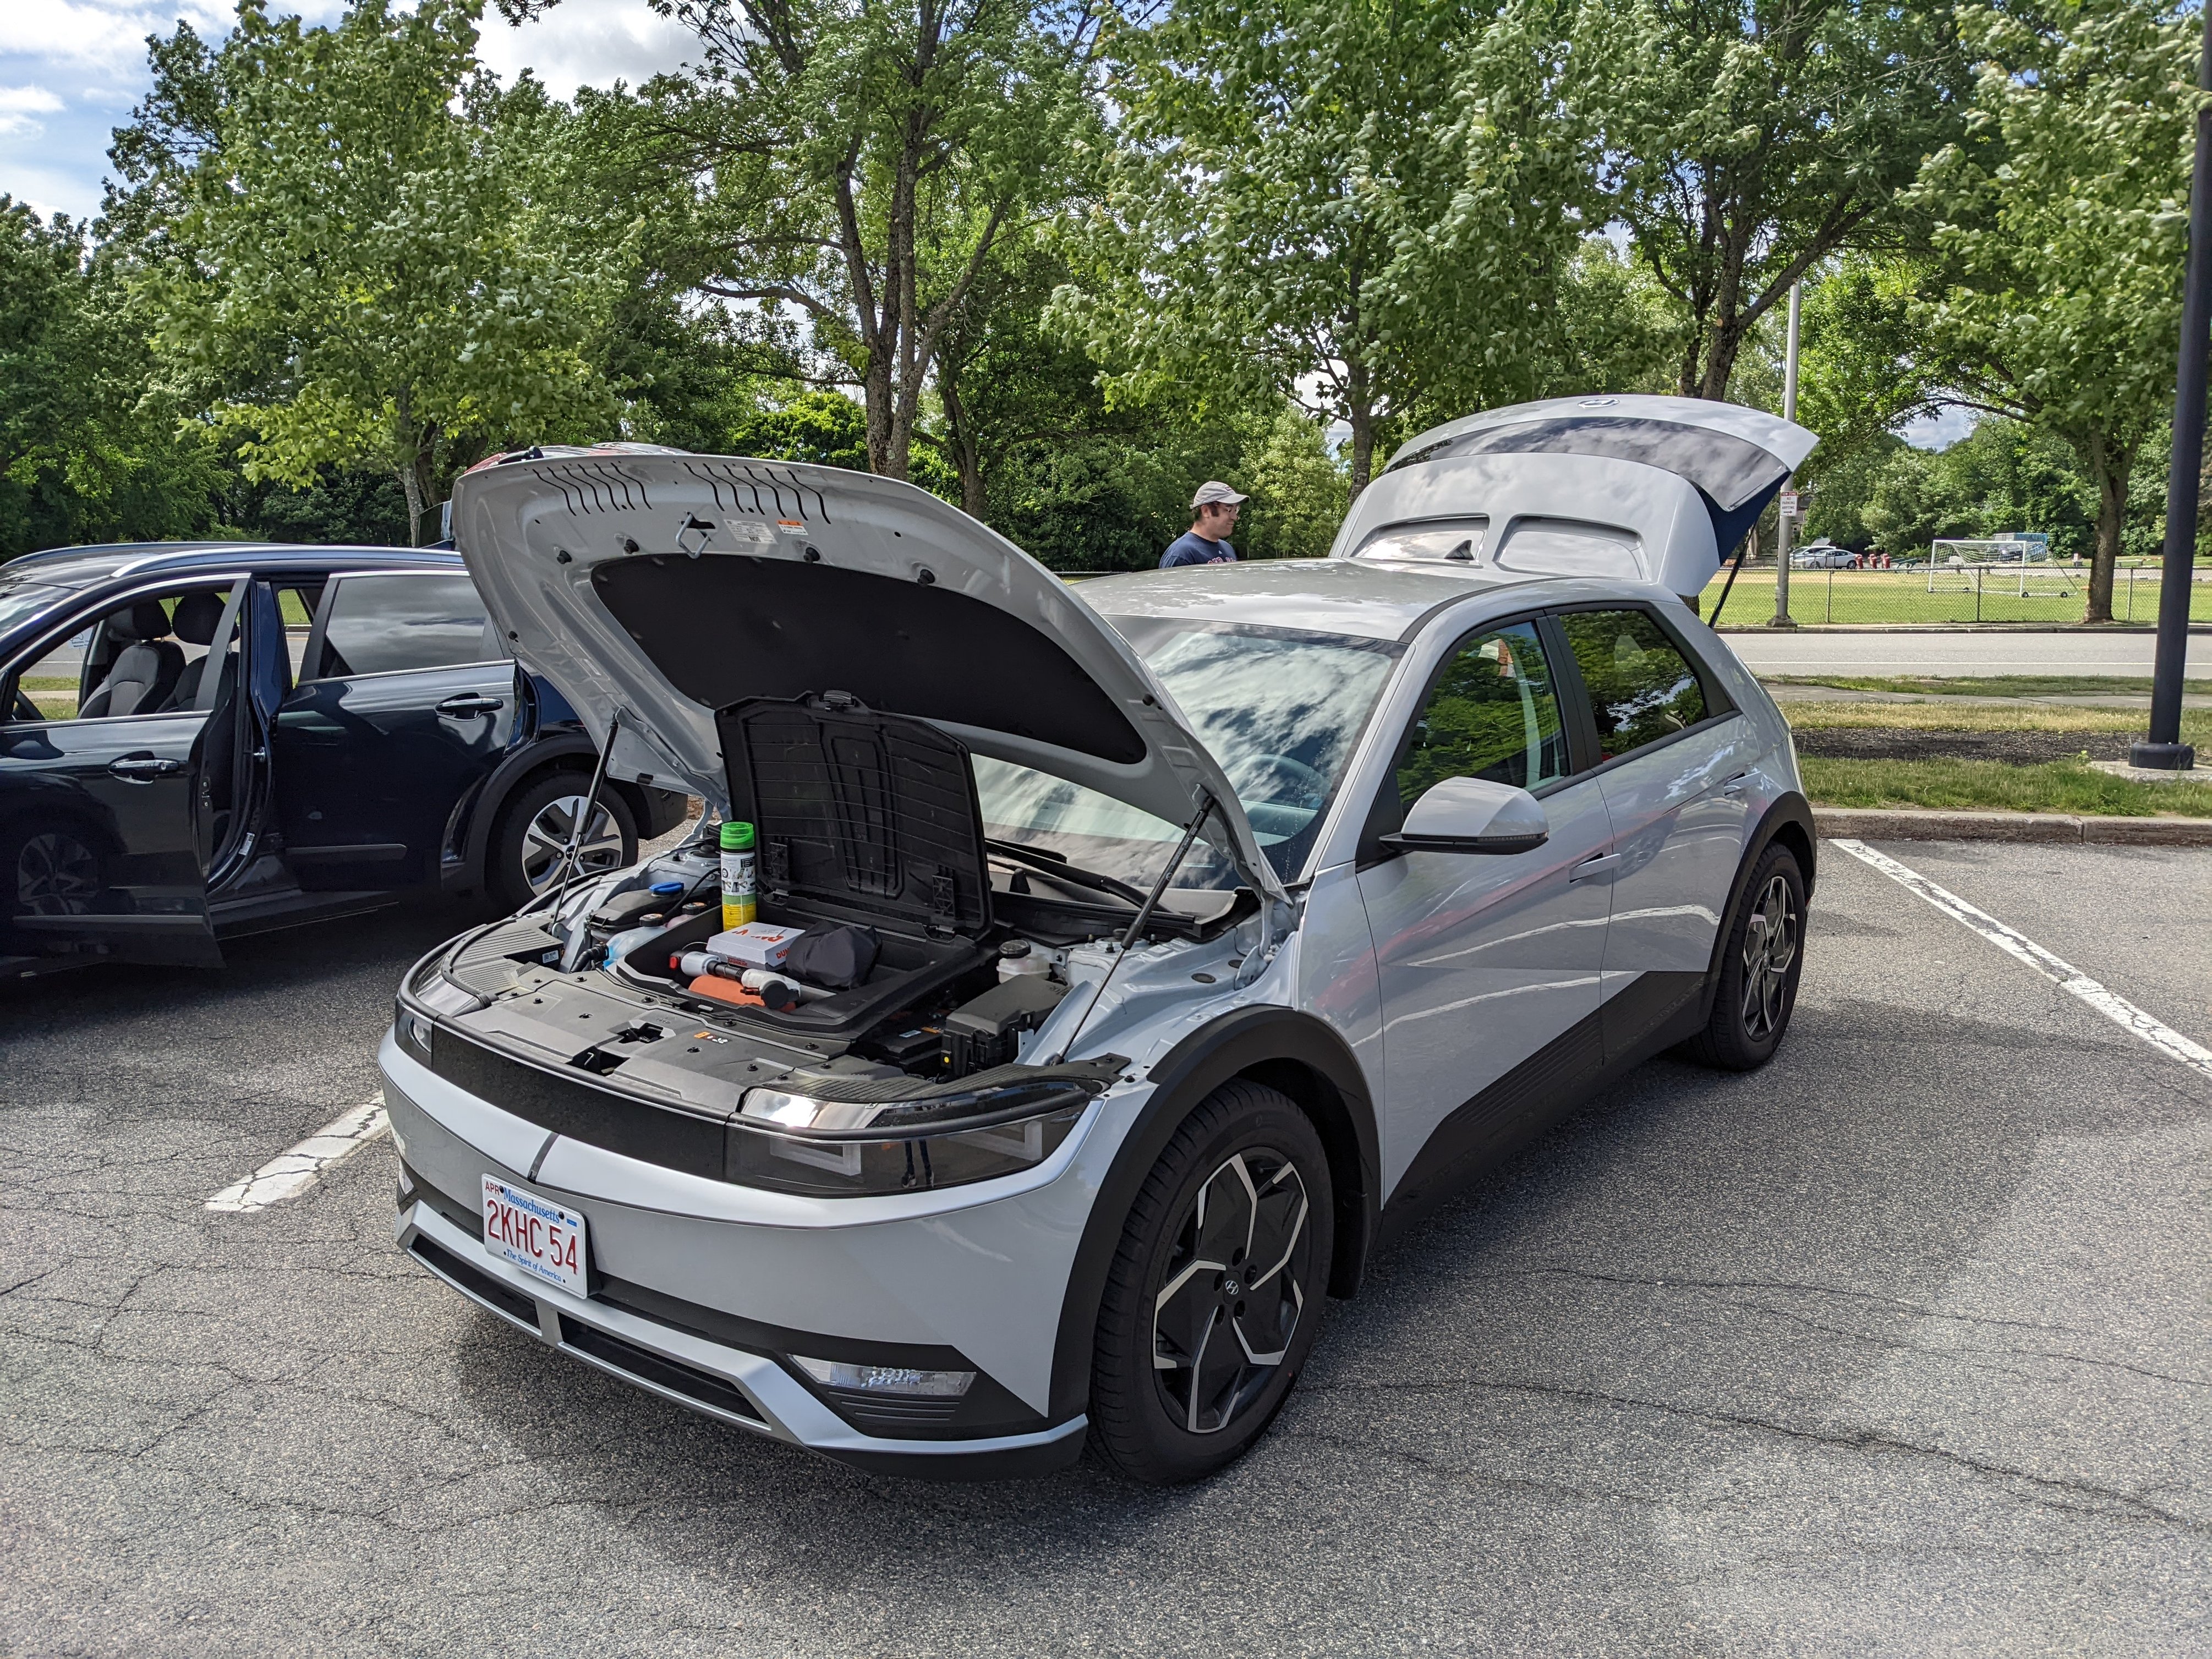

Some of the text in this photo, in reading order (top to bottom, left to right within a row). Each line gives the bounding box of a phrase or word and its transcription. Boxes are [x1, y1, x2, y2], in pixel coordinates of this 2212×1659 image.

[485, 1181, 500, 1196] APR
[503, 1187, 560, 1224] Massachusetts
[487, 1198, 578, 1275] 2KHC 54
[507, 1249, 561, 1282] The Spirit of America
